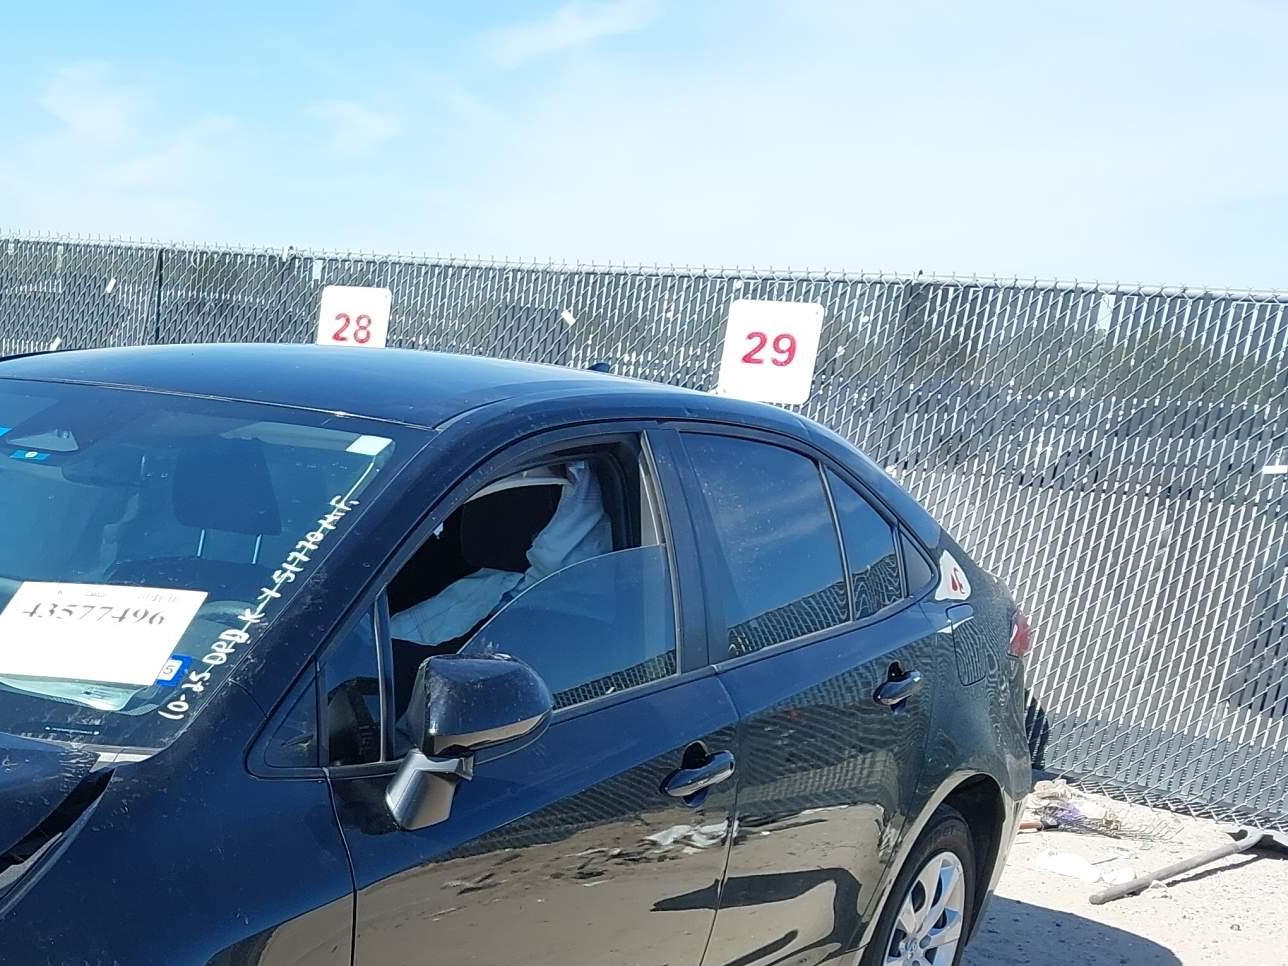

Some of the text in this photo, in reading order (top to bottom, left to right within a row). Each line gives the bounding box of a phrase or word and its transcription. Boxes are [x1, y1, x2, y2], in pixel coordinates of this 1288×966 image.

[332, 312, 372, 344] 28
[742, 331, 796, 367] 29
[23, 602, 165, 625] 43577496
